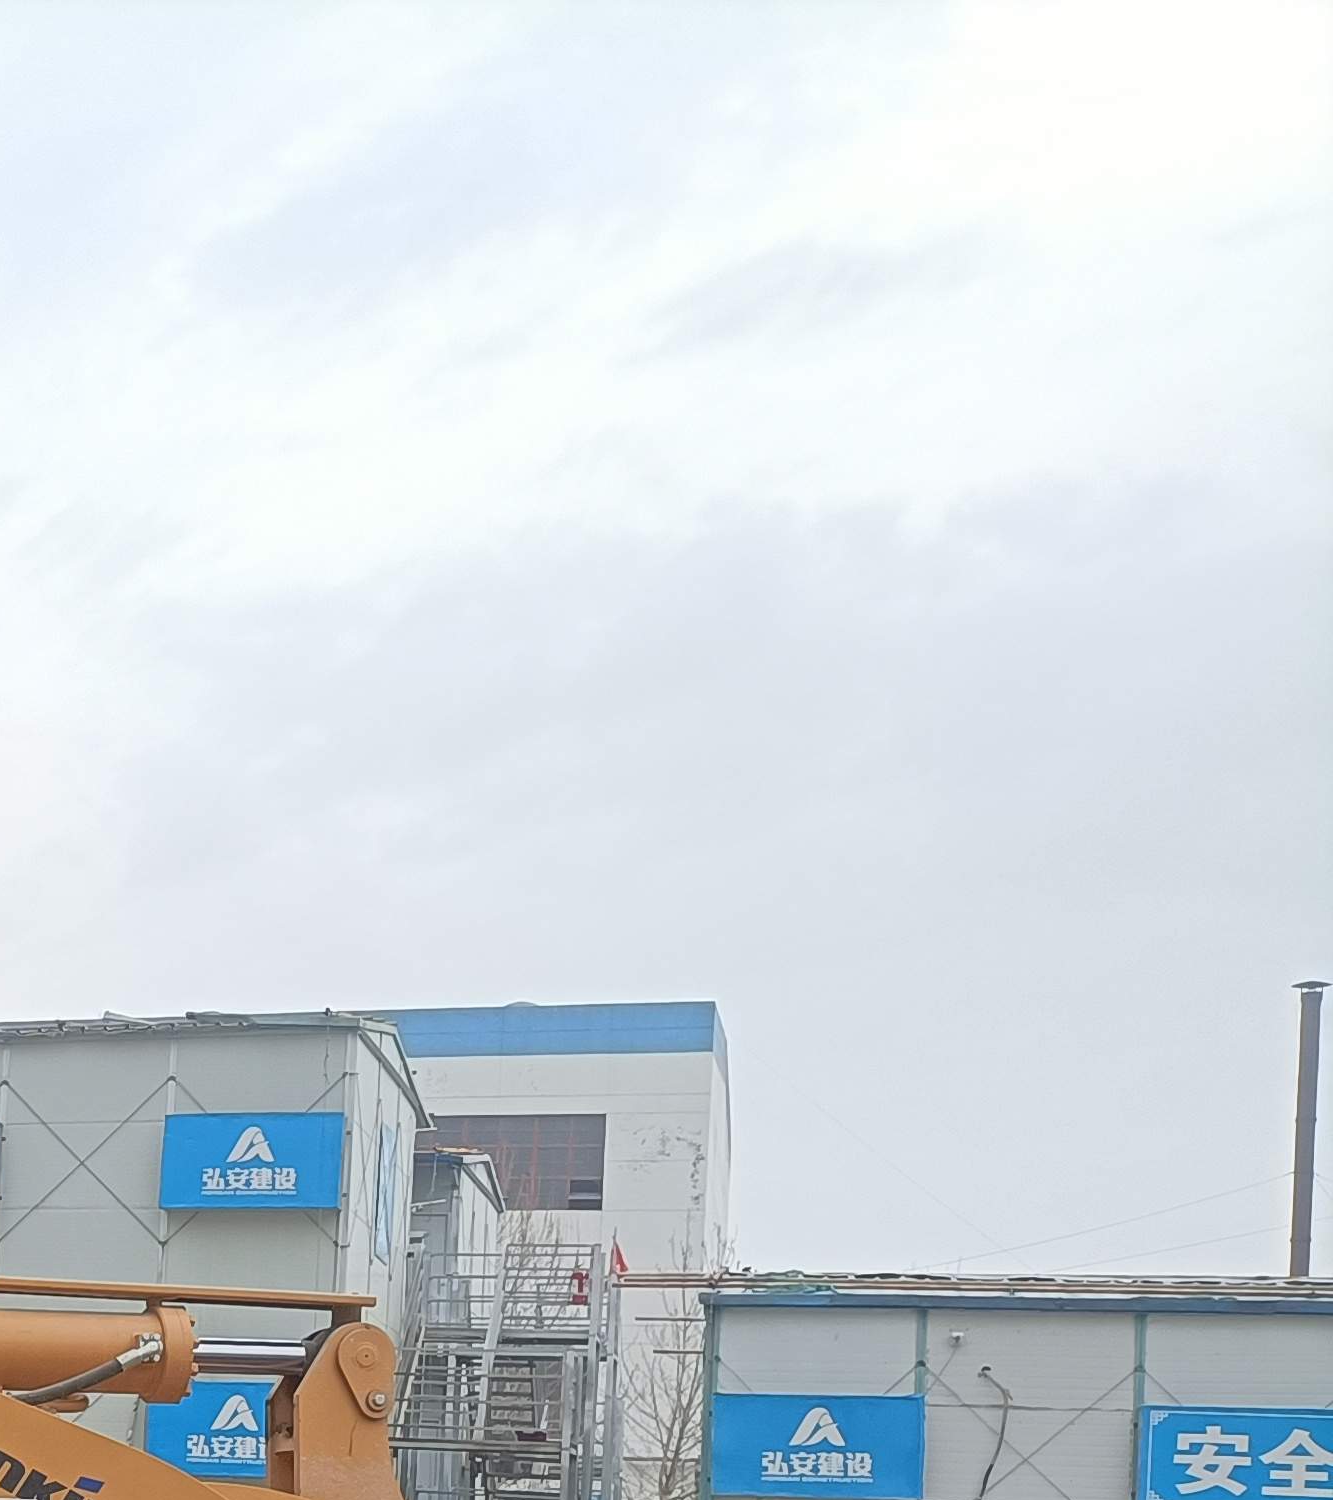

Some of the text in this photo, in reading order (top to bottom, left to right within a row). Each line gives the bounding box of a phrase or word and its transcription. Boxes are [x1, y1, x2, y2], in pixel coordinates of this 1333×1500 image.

[201, 1166, 297, 1190] 弘安建设
[760, 1451, 873, 1477] 弘安建设
[1172, 1425, 1333, 1498] 安全
